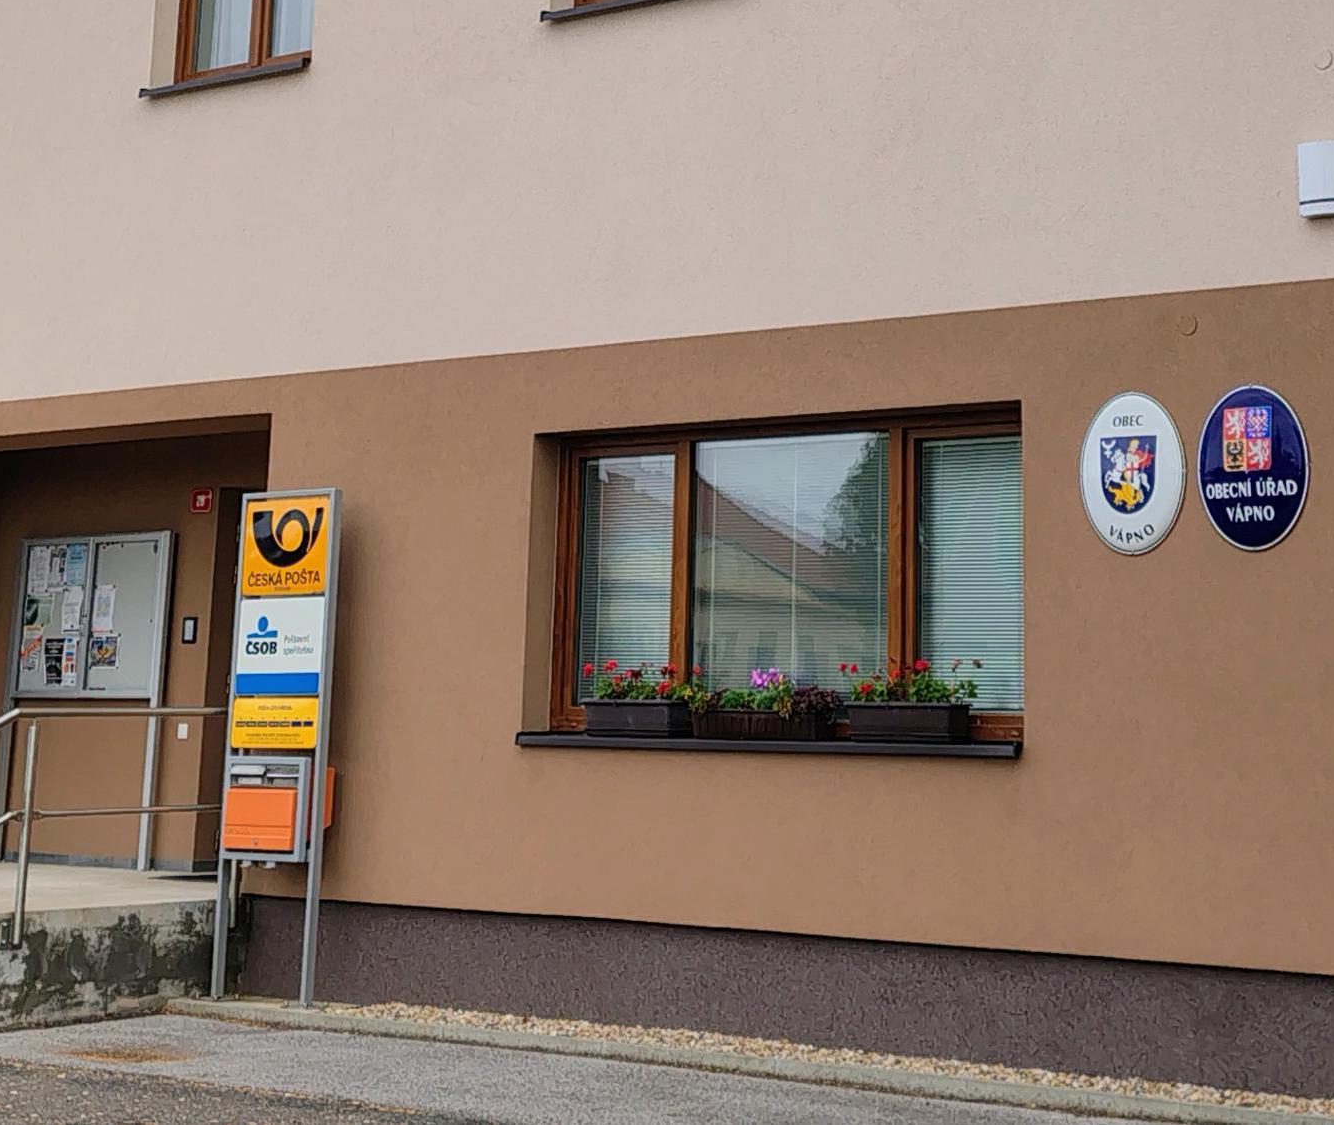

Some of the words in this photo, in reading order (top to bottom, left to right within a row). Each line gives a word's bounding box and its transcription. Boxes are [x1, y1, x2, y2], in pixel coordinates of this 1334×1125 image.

[1112, 415, 1144, 428] OBEC
[1206, 477, 1252, 500] OBECNÍ
[1255, 477, 1298, 497] ÚŘAD
[1226, 503, 1275, 522] VÁPNO
[1109, 523, 1155, 544] VÁPNO
[247, 569, 283, 587] ČESKÁ
[285, 568, 321, 585] POŠTA
[245, 640, 278, 655] ČSOB
